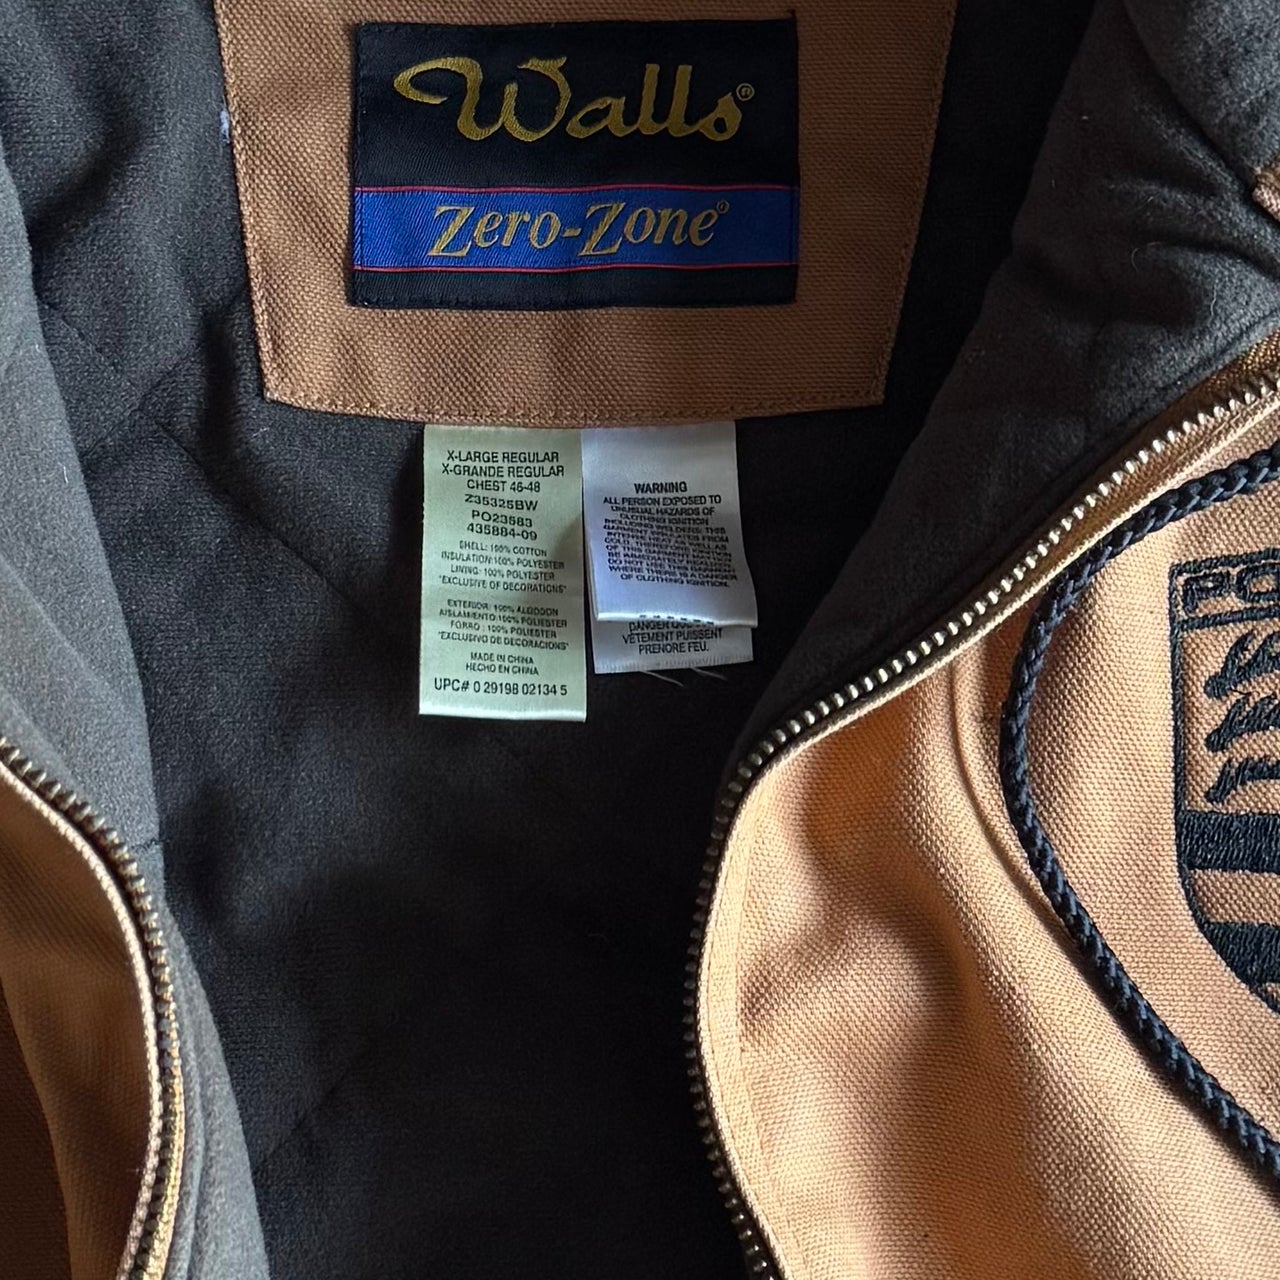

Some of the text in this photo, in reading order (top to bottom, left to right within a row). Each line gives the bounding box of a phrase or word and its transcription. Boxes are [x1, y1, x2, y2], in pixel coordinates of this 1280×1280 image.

[393, 56, 745, 142] Walls
[428, 202, 720, 257] Zero-Zone
[447, 450, 559, 463] X-LARGE REGULAR
[442, 463, 564, 477] X-GRANDE REGULAR
[467, 479, 540, 493] CHEST 46-48
[634, 481, 687, 494] WARNING
[464, 494, 538, 511] Z35325BW
[622, 497, 659, 506] PERSON
[662, 496, 706, 506] EXPOSED
[709, 495, 721, 504] TO
[656, 507, 700, 516] HAZARDS
[702, 507, 715, 516] OF
[513, 545, 547, 557] COTTON
[517, 559, 564, 569] POLYESTER
[507, 570, 555, 581] POLYESTER
[490, 581, 500, 590] OF
[521, 617, 567, 628] POLIESTER
[510, 627, 557, 638] POLIESTER
[677, 628, 723, 641] PUISSENT
[490, 636, 502, 645] DE
[688, 641, 709, 652] FEU.
[471, 652, 534, 664] MADE IN CHINA
[466, 662, 539, 675] HECHO EN CHINA
[435, 677, 567, 696] UPC# 0 29198 02134 5
